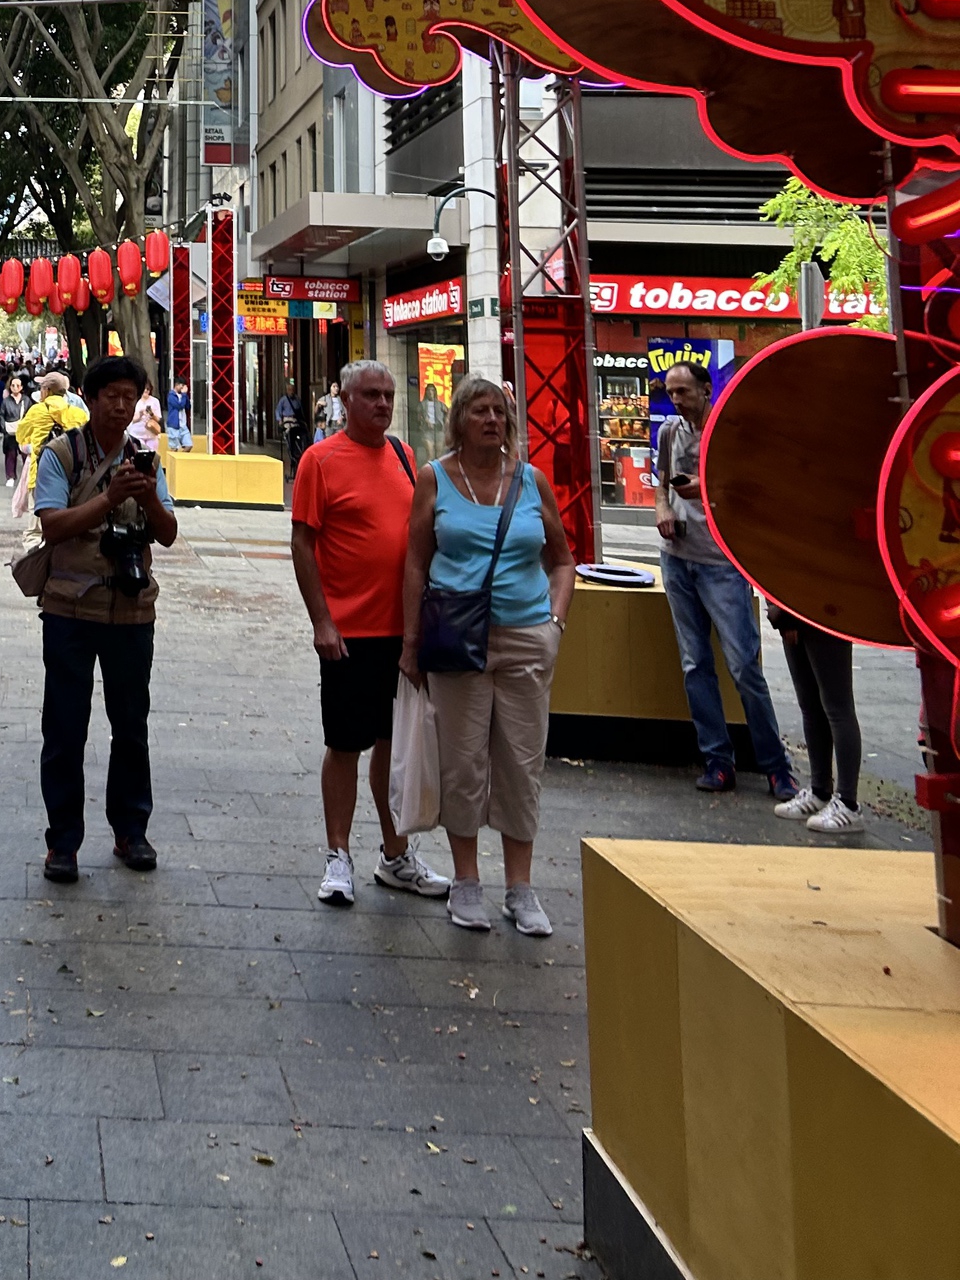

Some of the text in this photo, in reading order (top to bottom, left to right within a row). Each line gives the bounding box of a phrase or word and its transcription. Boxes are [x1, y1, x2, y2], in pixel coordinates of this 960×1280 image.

[268, 277, 294, 298] tsg
[304, 279, 350, 291] tobacco
[307, 288, 348, 299] station
[589, 282, 619, 312] sg
[629, 281, 790, 313] tobacco
[393, 297, 420, 323] tobacco
[421, 288, 449, 317] station
[593, 353, 650, 369] obacc
[648, 342, 712, 373] Twirl
